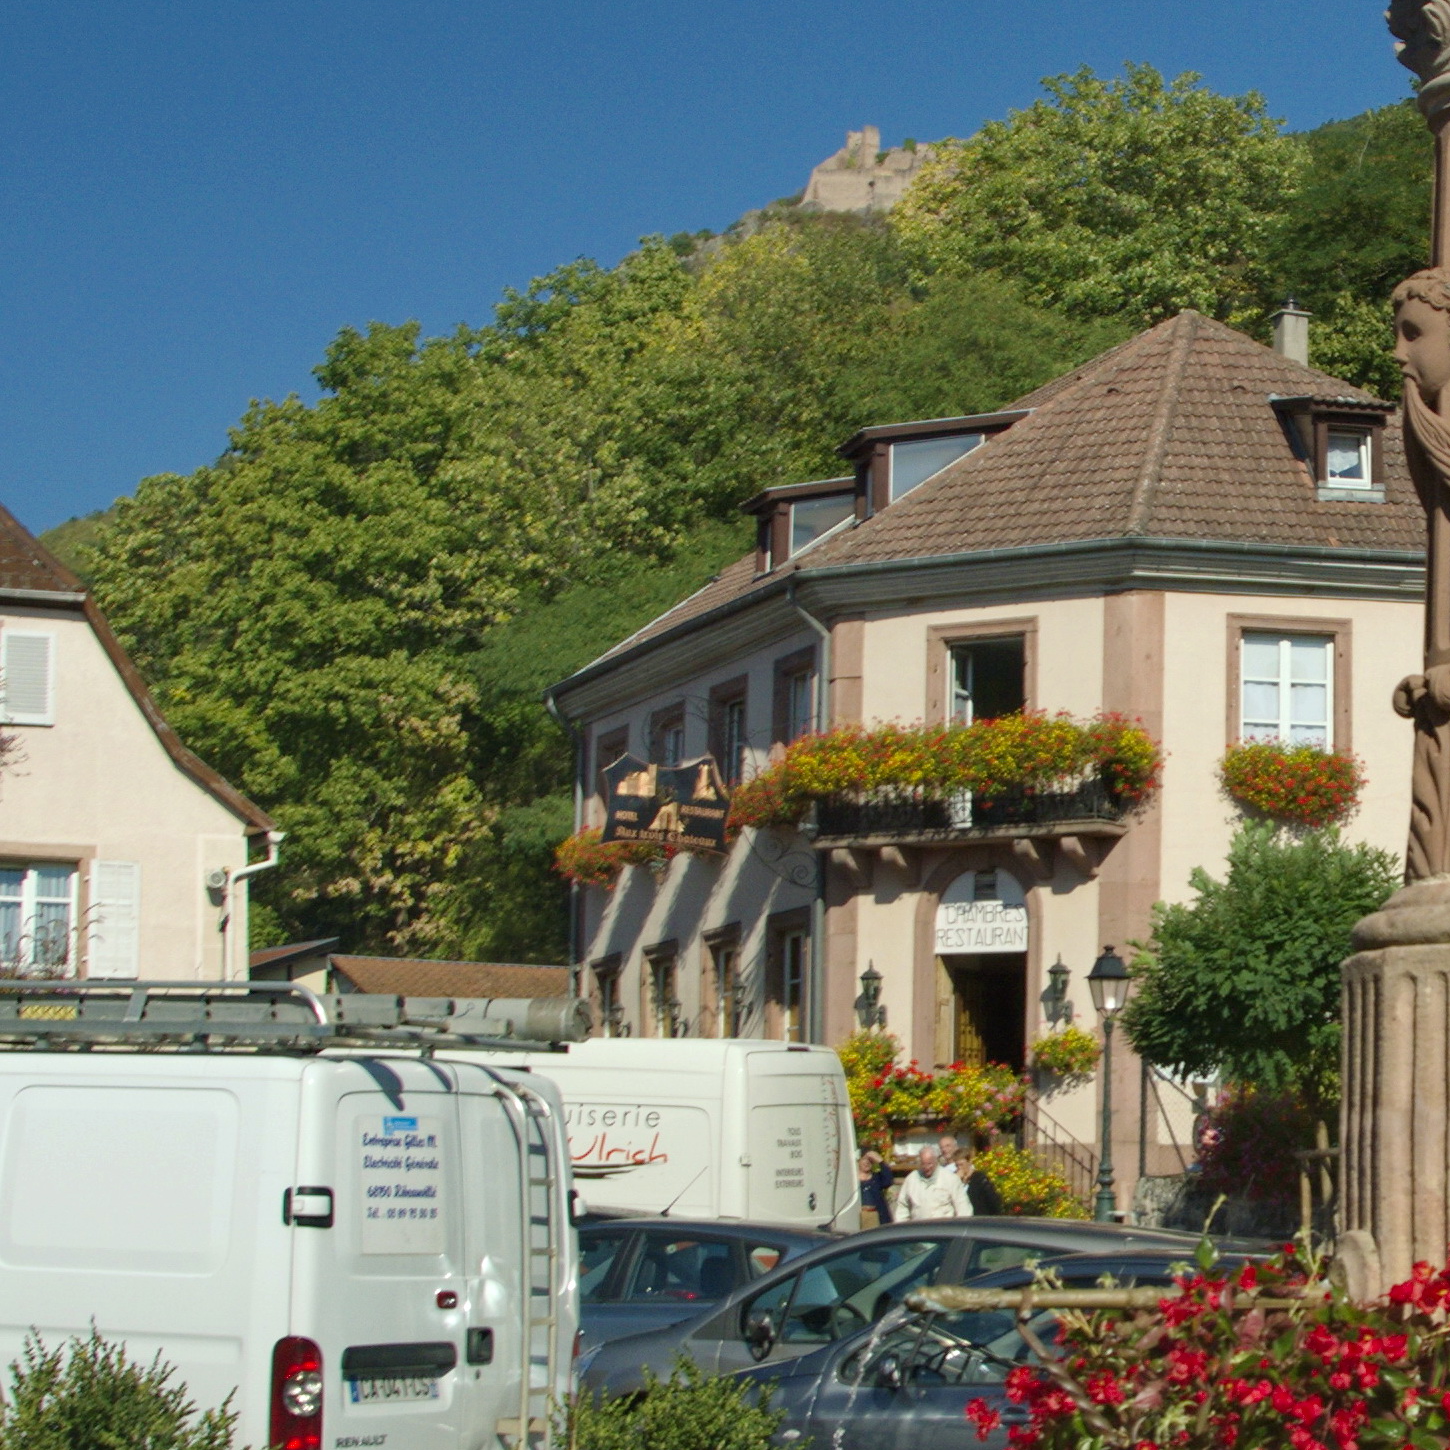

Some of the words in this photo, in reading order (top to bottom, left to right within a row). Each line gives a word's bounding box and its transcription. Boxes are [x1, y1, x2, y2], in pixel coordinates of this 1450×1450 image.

[680, 805, 725, 820] RESTAURANT
[945, 903, 1024, 925] CHAMBRES
[335, 1434, 387, 1448] RENAULT
